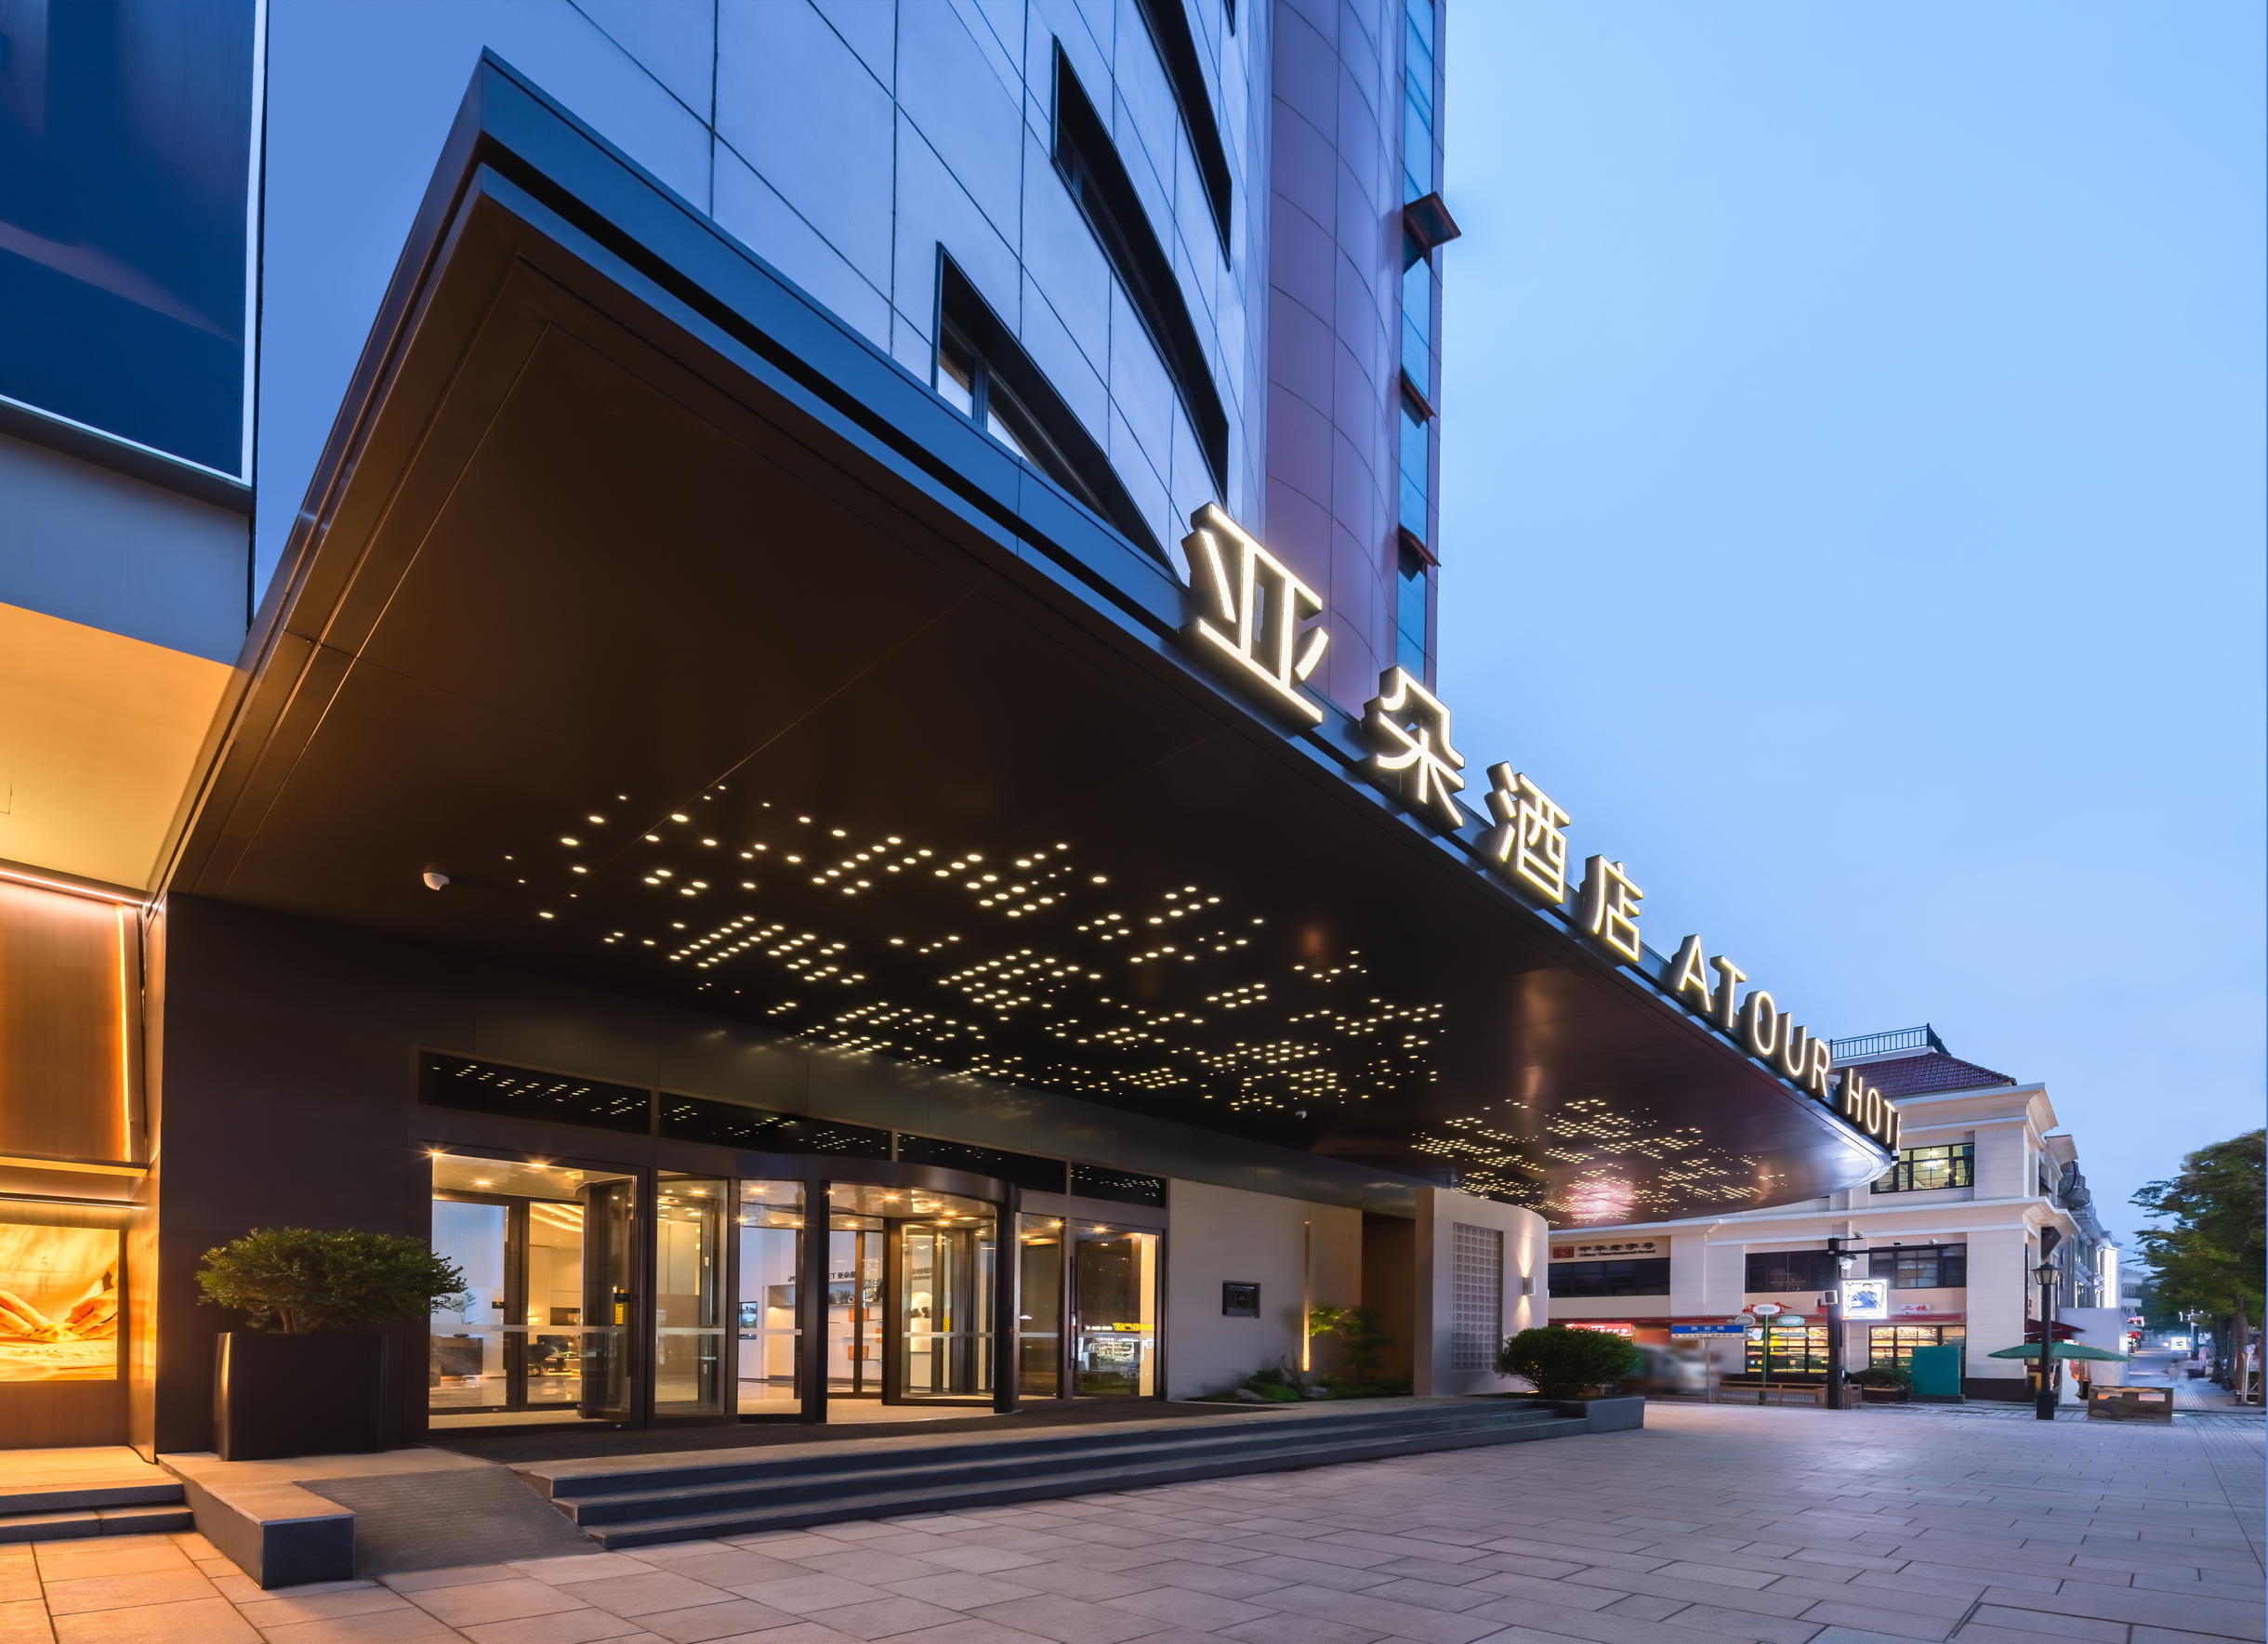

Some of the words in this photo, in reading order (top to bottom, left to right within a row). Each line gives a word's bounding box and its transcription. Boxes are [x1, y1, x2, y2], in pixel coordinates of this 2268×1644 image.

[1195, 502, 1643, 962] 亚朵酒店
[1678, 933, 1831, 1098] ATOUR
